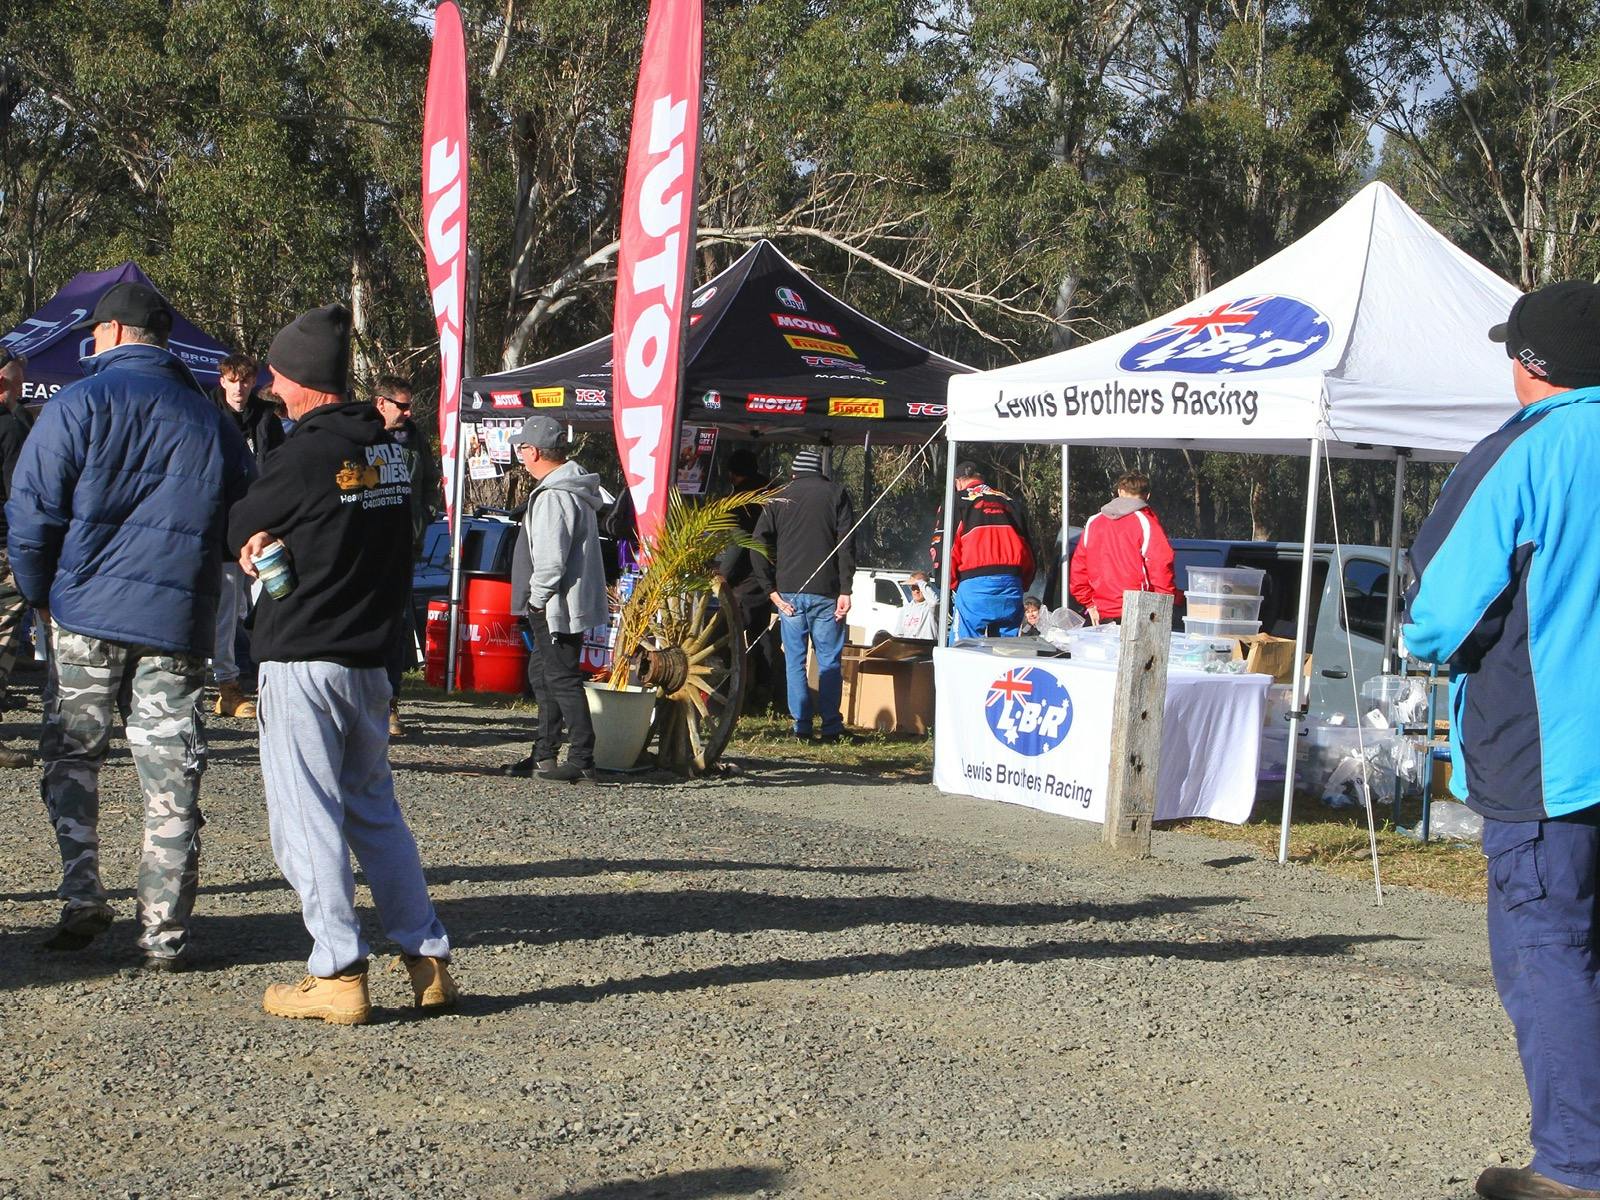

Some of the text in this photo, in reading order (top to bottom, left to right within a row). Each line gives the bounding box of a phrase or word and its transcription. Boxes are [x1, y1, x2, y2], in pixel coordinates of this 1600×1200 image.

[777, 316, 837, 336] MOTUL
[575, 388, 606, 403] TCX
[748, 397, 804, 411] MOTUL
[994, 380, 1259, 426] Lewis Brothers Racing
[834, 401, 880, 414] PIRELLI
[907, 402, 948, 416] TC
[380, 463, 411, 485] DIES
[1045, 773, 1093, 808] Racing
